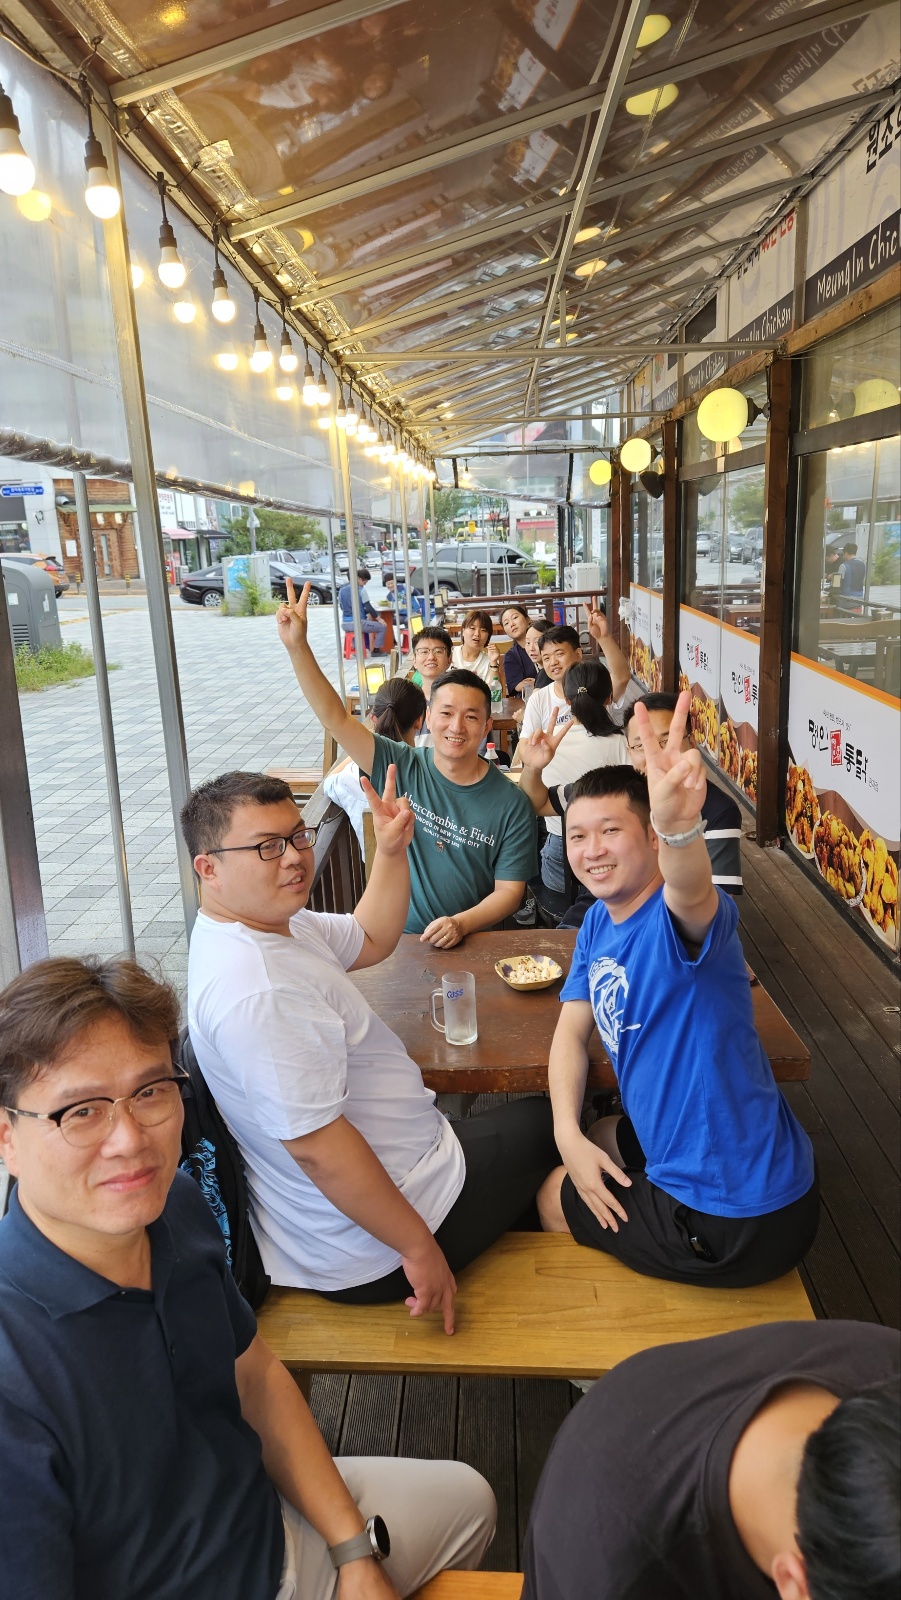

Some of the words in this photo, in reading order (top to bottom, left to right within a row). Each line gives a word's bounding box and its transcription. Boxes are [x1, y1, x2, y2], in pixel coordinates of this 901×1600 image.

[868, 223, 901, 270] Chic
[761, 305, 791, 342] Chicken
[808, 719, 829, 752] 명인
[843, 742, 869, 783] 통닭
[458, 826, 468, 836] &
[469, 826, 496, 847] Fitch
